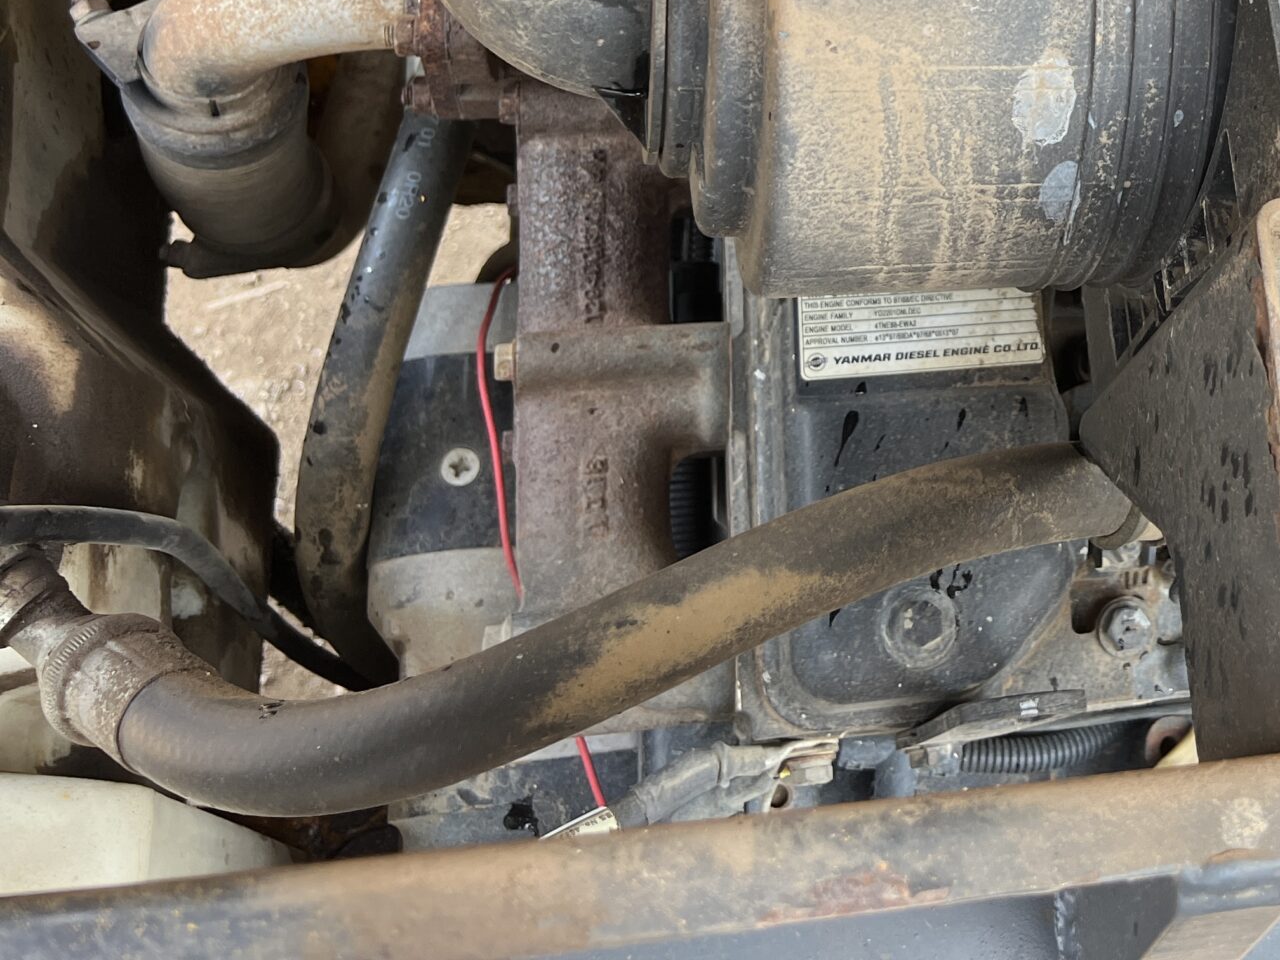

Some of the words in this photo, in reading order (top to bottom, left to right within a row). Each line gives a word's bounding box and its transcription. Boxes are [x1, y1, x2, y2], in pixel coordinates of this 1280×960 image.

[804, 301, 818, 310] THIS
[820, 300, 844, 309] ENGINE
[846, 298, 882, 307] CONFORMS
[883, 296, 892, 304] TO
[921, 292, 953, 302] DIRECTIVE
[804, 312, 828, 322] ENGINE
[830, 311, 853, 320] FAMILY
[804, 324, 828, 333] ENGINE
[830, 323, 853, 333] MODEL
[805, 336, 839, 346] APPROVAL
[841, 334, 868, 344] NUMBER
[833, 352, 892, 365] YANMAR
[895, 349, 940, 360] DIESEL
[943, 345, 990, 356] ENGINE
